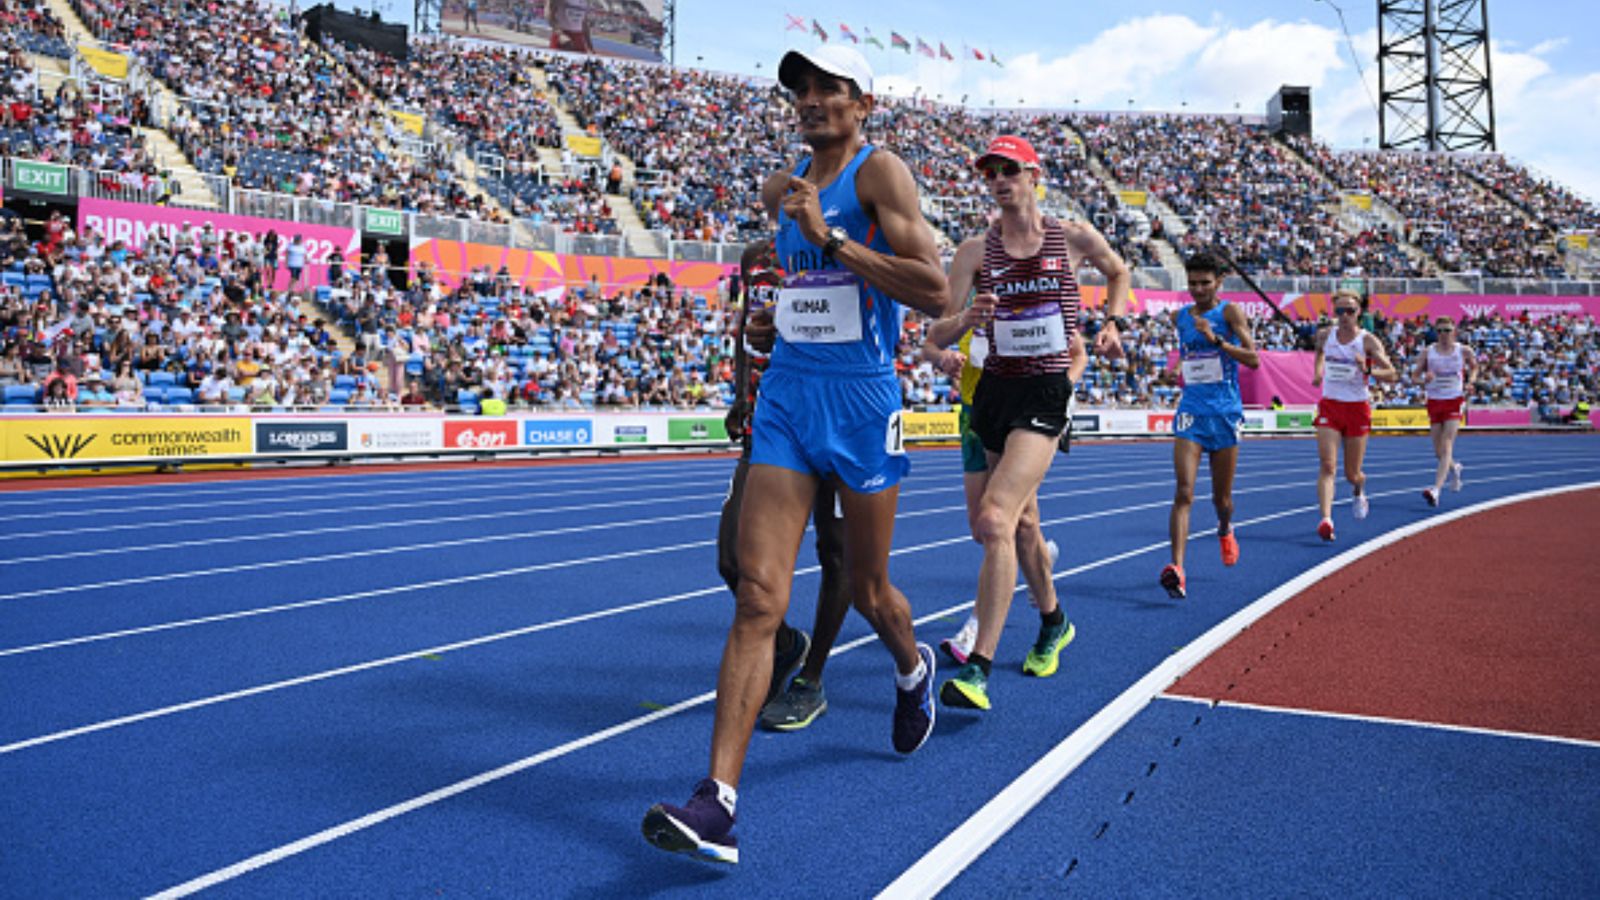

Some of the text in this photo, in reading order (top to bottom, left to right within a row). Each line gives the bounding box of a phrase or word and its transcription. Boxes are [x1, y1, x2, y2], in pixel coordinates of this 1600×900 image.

[18, 167, 63, 187] EXIT
[367, 212, 399, 229] EXIT
[274, 231, 334, 265] 222
[993, 276, 1060, 297] CANADA
[110, 427, 241, 446] commonwealth
[269, 431, 338, 445] LONGINES
[529, 430, 573, 443] CHASE
